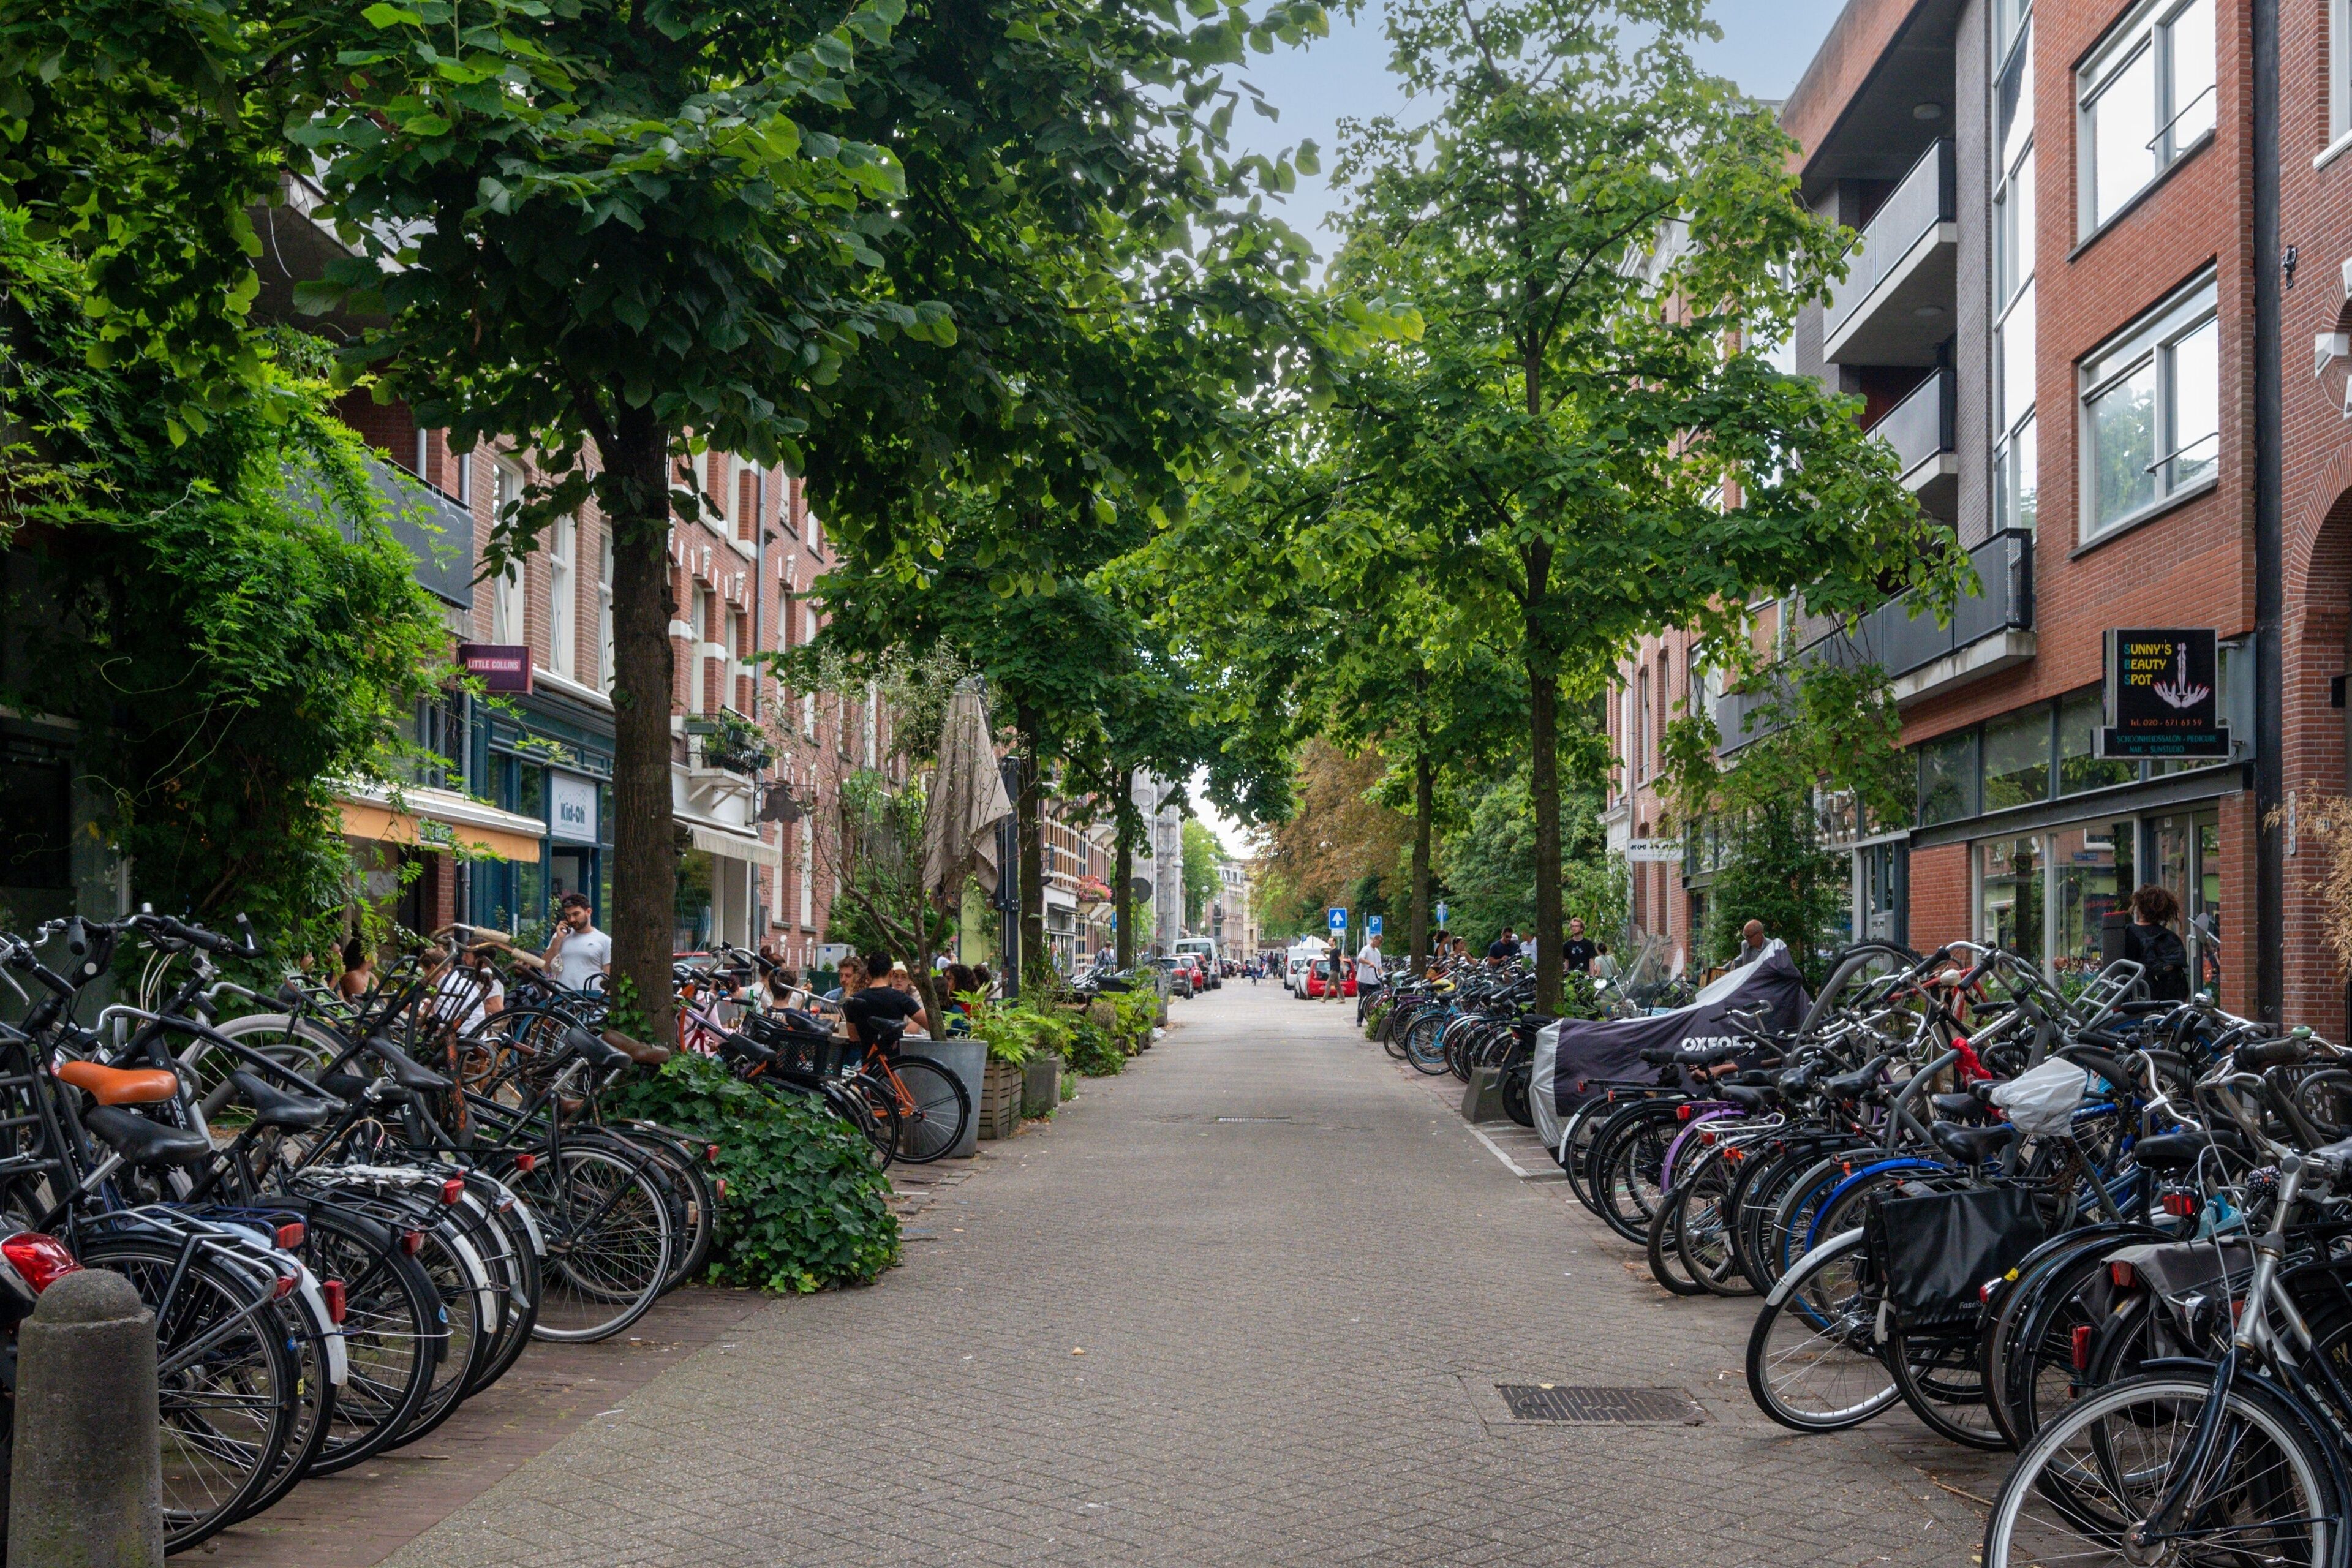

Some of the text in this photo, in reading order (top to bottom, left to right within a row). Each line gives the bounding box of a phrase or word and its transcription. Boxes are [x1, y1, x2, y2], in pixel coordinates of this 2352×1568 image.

[2124, 643, 2173, 655] SUNNY'S
[468, 660, 519, 669] LITTLE COLLINS
[2124, 658, 2167, 670] BEAUTY
[2124, 674, 2153, 685] SPOT
[560, 802, 585, 824] Kid-Oh
[1371, 918, 1379, 928] P
